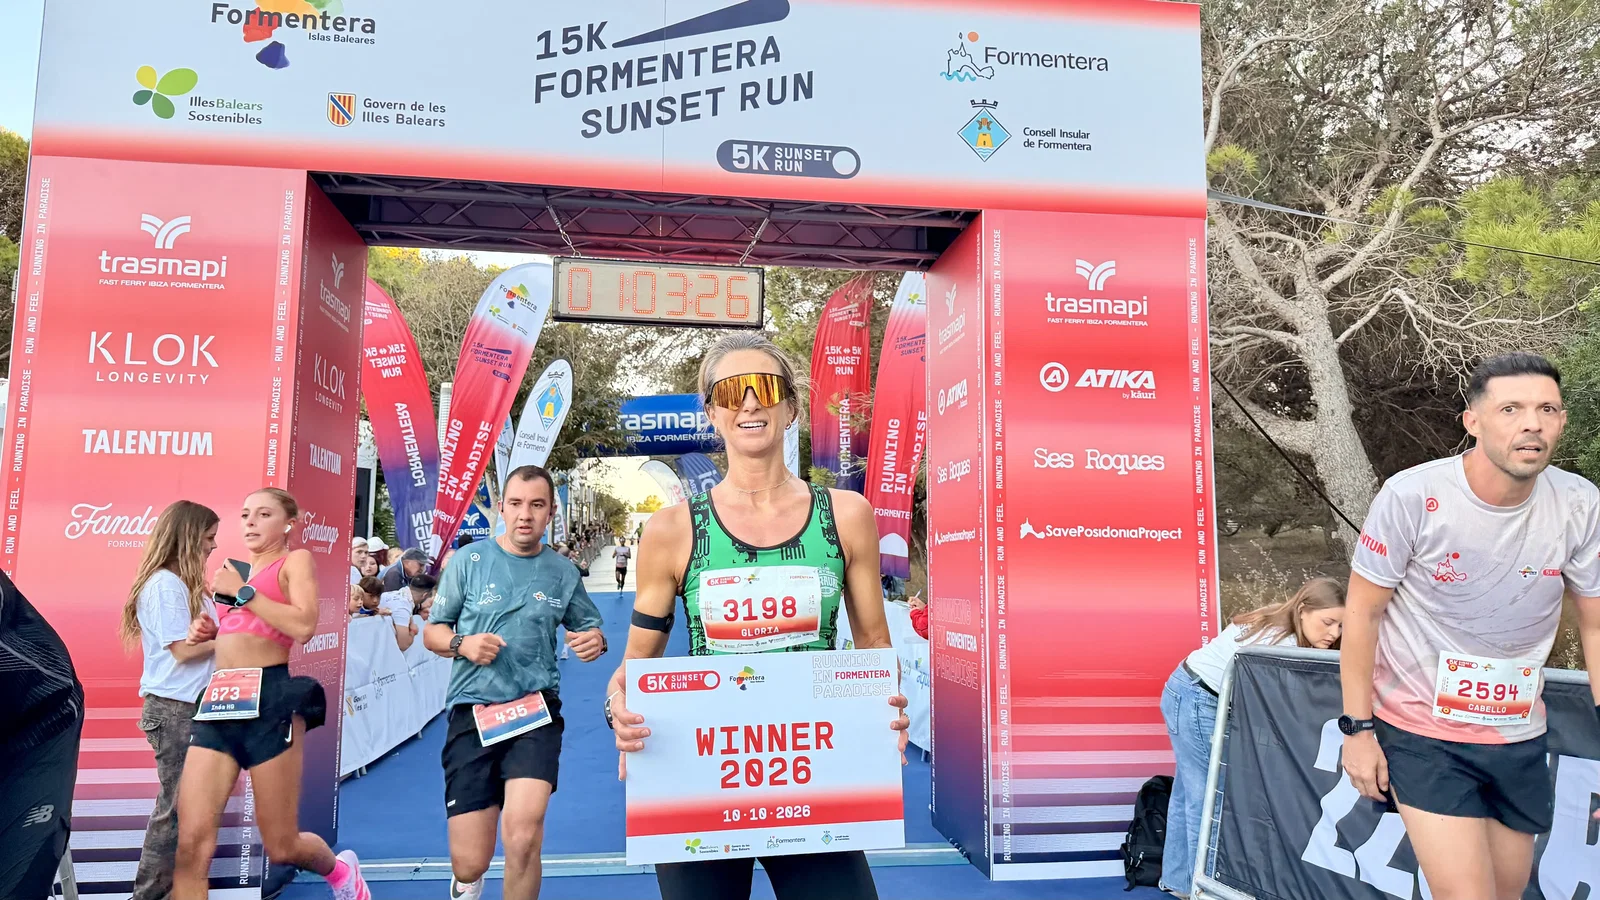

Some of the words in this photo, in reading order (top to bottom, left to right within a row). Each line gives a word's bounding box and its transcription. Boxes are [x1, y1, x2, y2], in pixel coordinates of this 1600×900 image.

[211, 3, 376, 34] Formentera
[308, 33, 331, 42] Islas
[334, 34, 376, 44] Baleares
[536, 21, 608, 60] 15K
[984, 46, 1108, 72] Formentera
[534, 35, 781, 104] FORMENTERA
[189, 96, 263, 111] IllesBalears
[363, 98, 406, 112] Govern
[410, 100, 426, 112] de
[428, 101, 446, 114] les
[580, 86, 725, 138] SUNSET
[740, 71, 814, 112] RUN
[188, 110, 262, 125] Sostenibles
[362, 112, 390, 124] Illes
[396, 114, 446, 128] Balears
[1023, 127, 1056, 138] Consell
[1060, 128, 1090, 140] Insular
[1024, 138, 1034, 148] de
[1038, 140, 1092, 151] Formentera
[732, 144, 770, 171] 5K
[774, 147, 832, 162] SUNSET
[774, 160, 804, 172] RUN
[39, 177, 50, 218] PARADISE
[283, 190, 294, 229] PARADISE
[37, 223, 46, 233] IN
[282, 234, 290, 244] IN
[34, 239, 44, 274] RUNNING
[99, 251, 226, 280] trasmapi
[280, 249, 290, 284] RUNNING
[121, 279, 146, 287] FERRY
[170, 282, 225, 290] FORMENTERA
[994, 270, 1000, 279] IN
[1190, 277, 1197, 286] IN
[30, 291, 39, 311] FEEL
[278, 300, 286, 320] FEEL
[320, 279, 350, 322] trasmapi
[1045, 292, 1148, 318] trasmapi
[28, 316, 36, 332] AND
[276, 325, 285, 340] AND
[25, 337, 34, 353] RUN
[88, 331, 219, 368] KLOK
[274, 346, 284, 361] RUN
[825, 346, 842, 354] 15K
[852, 346, 862, 354] 5K
[895, 339, 925, 350] FORMENTE
[828, 356, 860, 364] SUNSET
[96, 372, 209, 384] LONGEVITY
[314, 353, 346, 400] KLOK
[836, 366, 853, 375] RUN
[1075, 368, 1156, 389] ATIKA
[19, 369, 31, 411] PARADISE
[271, 376, 282, 418] PARADISE
[315, 392, 342, 413] LONGEVITY
[18, 417, 26, 427] IN
[270, 423, 278, 433] IN
[14, 433, 24, 470] RUNNING
[82, 429, 212, 456] TALENTUM
[267, 439, 277, 475] RUNNING
[310, 444, 342, 476] TALENTUM
[455, 420, 493, 501] PARADISE
[881, 419, 900, 493] RUNNING
[1034, 448, 1074, 468] Ses
[1085, 449, 1164, 474] Roques
[937, 466, 948, 484] Ses
[949, 459, 970, 482] Roques
[445, 475, 459, 498] IN
[895, 474, 907, 494] IN
[10, 487, 20, 509] FEEL
[8, 514, 17, 531] AND
[874, 508, 911, 520] FORMENTE
[1046, 525, 1182, 542] SavePosidoniaProject
[6, 536, 14, 553] RUN
[723, 596, 796, 621] 3198
[742, 626, 779, 636] GLORIA
[946, 630, 978, 652] FORMENTERA
[812, 653, 880, 668] RUNNING
[647, 675, 668, 690] 5K
[670, 673, 704, 682] SUNSET
[670, 682, 688, 690] RUN
[813, 670, 832, 684] IN
[835, 670, 890, 680] FORMENTERA
[211, 686, 240, 702] 673
[813, 682, 892, 698] PARADISE
[1458, 680, 1518, 701] 2594
[495, 704, 528, 724] 435
[1468, 704, 1506, 714] CABELLO
[696, 721, 834, 757] WINNER
[720, 756, 812, 789] 2026
[242, 826, 251, 838] IN
[240, 844, 249, 884] RUNNING
